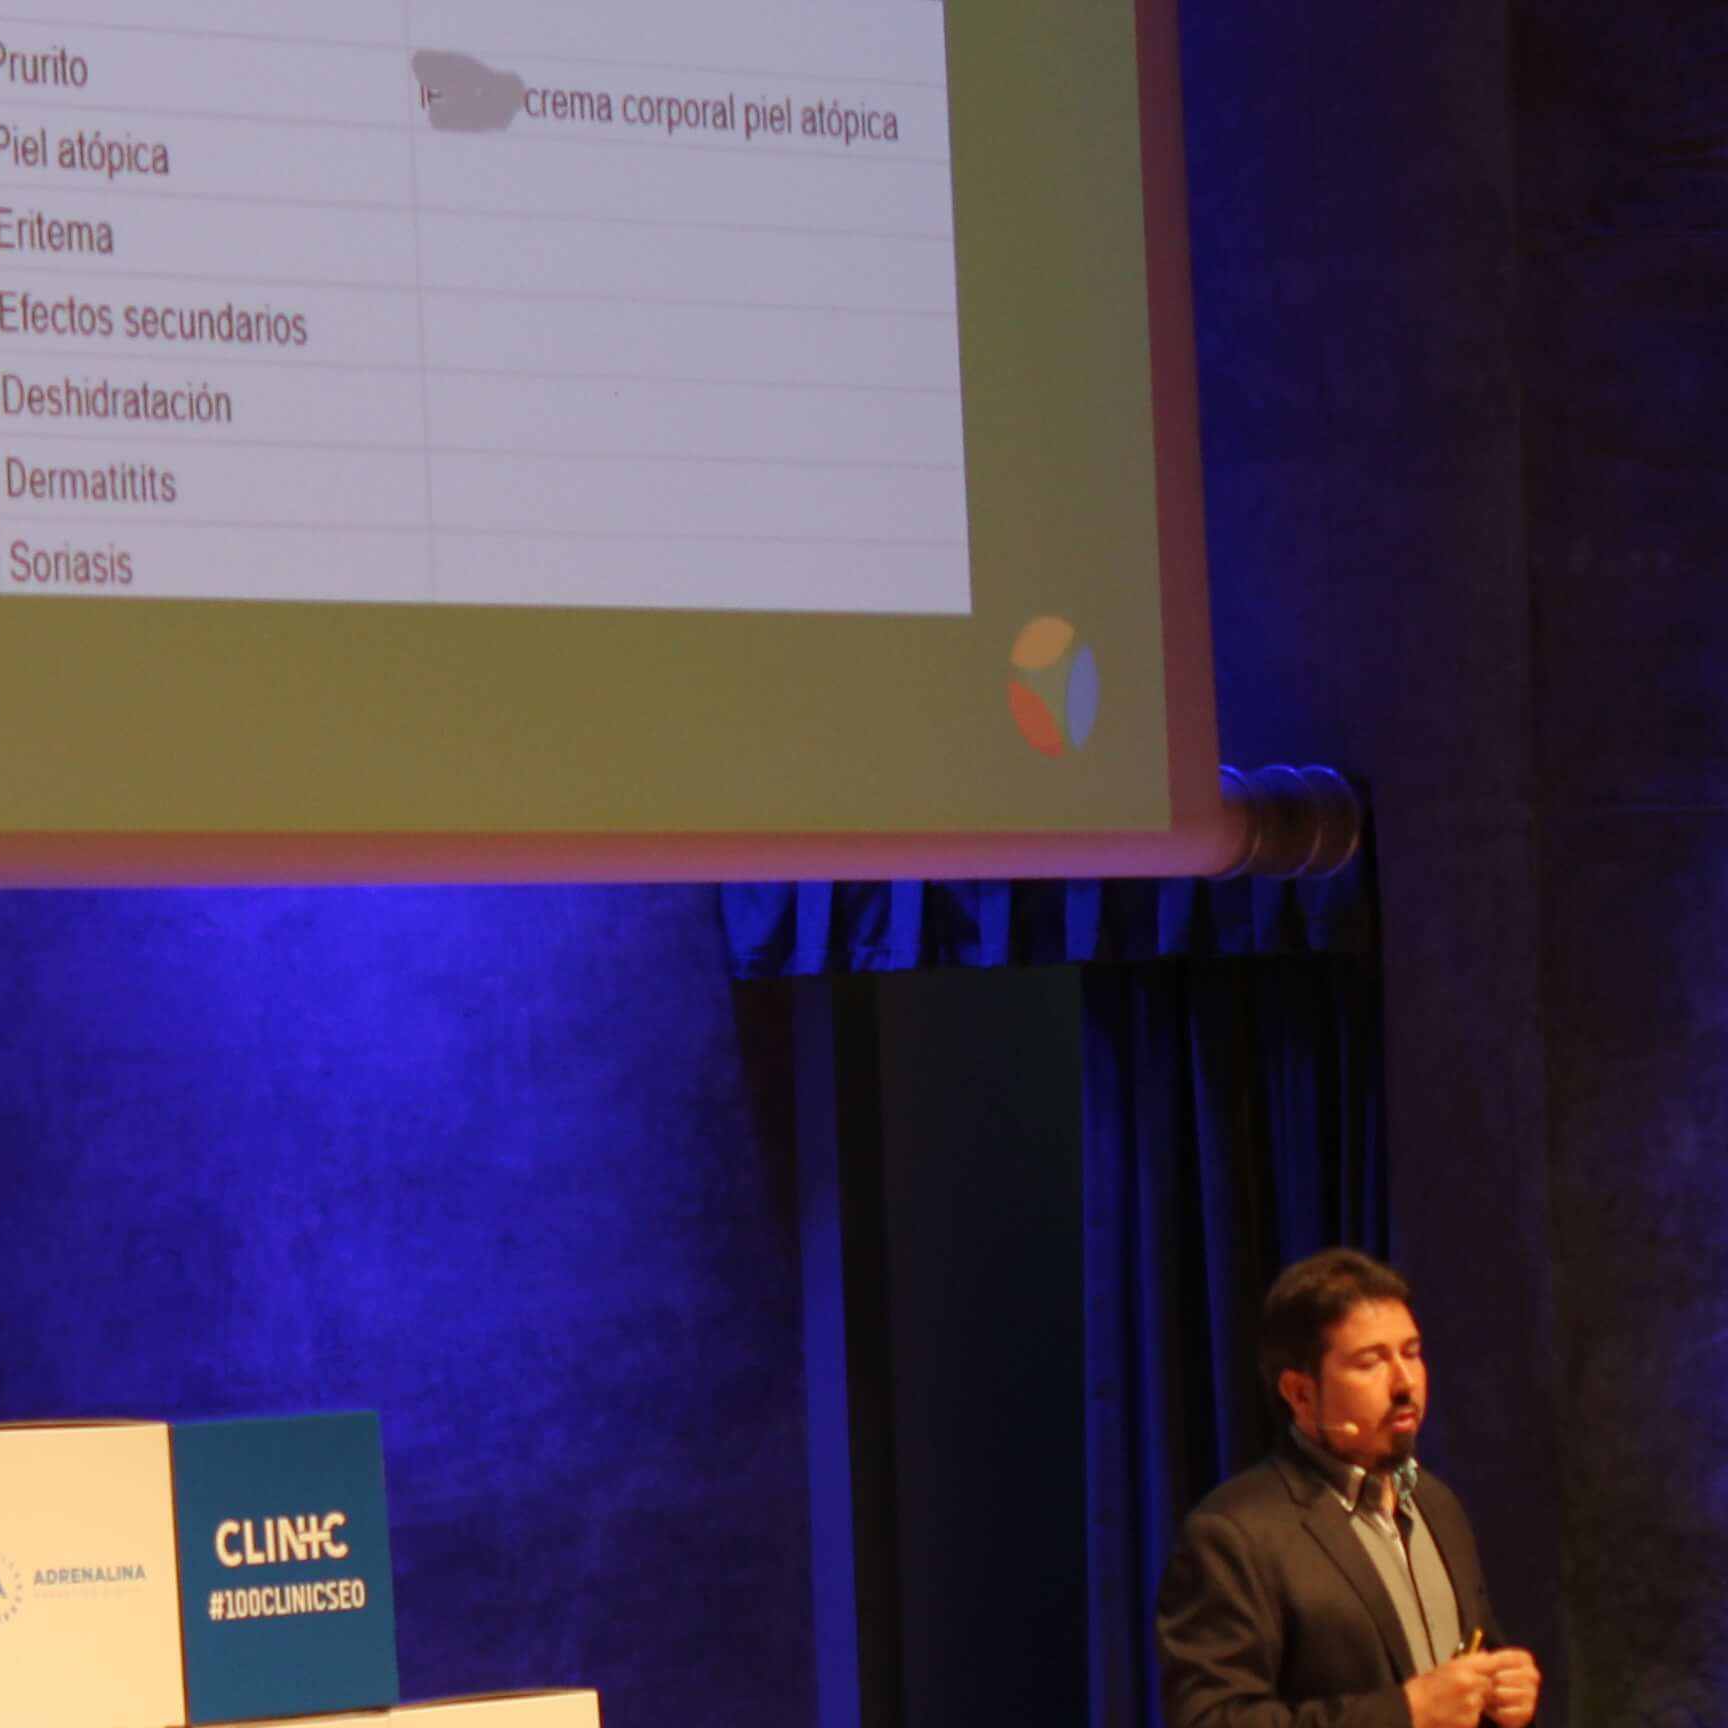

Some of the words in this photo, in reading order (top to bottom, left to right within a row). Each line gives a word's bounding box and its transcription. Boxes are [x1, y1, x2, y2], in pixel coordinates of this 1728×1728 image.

[523, 81, 613, 128] crema
[623, 89, 736, 140] corporal
[745, 93, 791, 140] piel
[801, 100, 899, 150] atópica
[58, 128, 169, 181] atópica
[125, 301, 308, 345] secundarios
[1, 374, 232, 425] Deshidratación
[5, 457, 176, 506] Dermatitits
[9, 541, 133, 586] Soriasis
[33, 1563, 146, 1588] ADRENALINA
[210, 1578, 366, 1622] #100CLINICSEO
